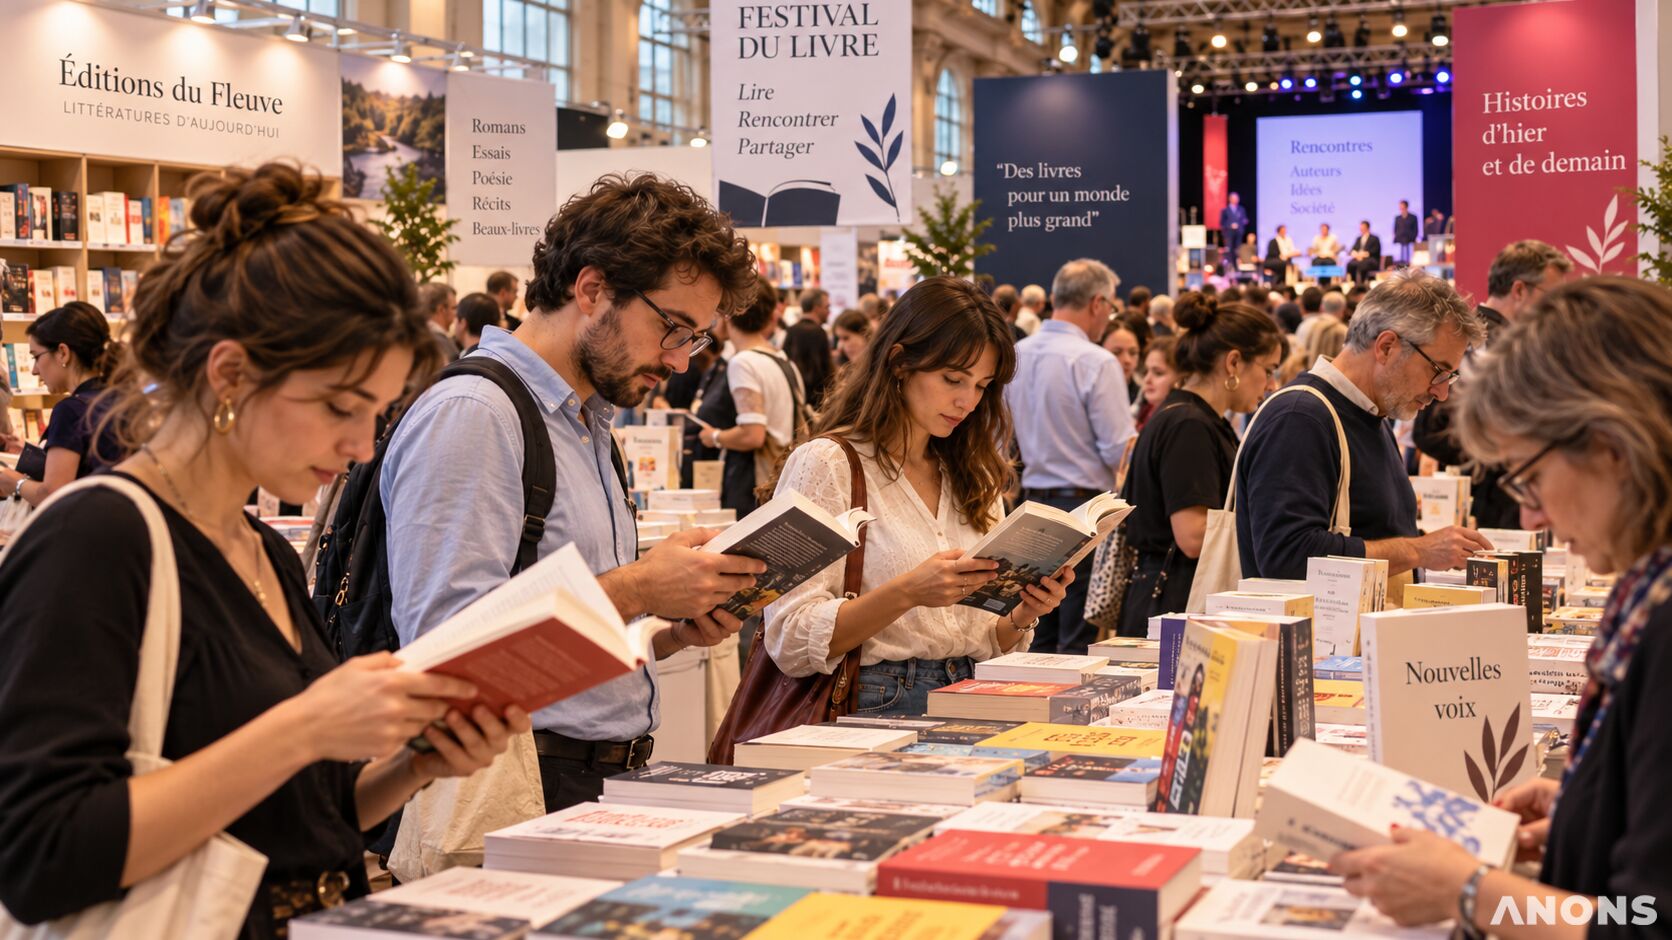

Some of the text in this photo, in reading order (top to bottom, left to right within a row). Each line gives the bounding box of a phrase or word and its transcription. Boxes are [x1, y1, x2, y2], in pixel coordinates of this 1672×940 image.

[738, 3, 880, 29] FESTIVAL
[738, 33, 880, 60] DU LIVRE
[58, 53, 283, 115] Éditions du Fleuve
[738, 83, 775, 101] Lire
[1482, 87, 1589, 114] Histoires
[63, 101, 281, 139] LITTÉRATURES D'AUJOURD'HUI
[472, 118, 527, 136] Romans
[738, 110, 839, 128] Rencontrer
[472, 144, 512, 160] Essais
[738, 137, 815, 159] Partager
[1290, 139, 1374, 154] Rencontres
[1038, 162, 1083, 179] livres
[1289, 165, 1343, 178] Auteurs
[1482, 149, 1628, 176] et de demain
[472, 170, 514, 186] Poésie
[1007, 184, 1131, 207] pour un monde
[1290, 182, 1323, 197] Idées
[472, 195, 512, 212] Récits
[1290, 201, 1336, 215] Société
[472, 221, 541, 236] Beaux-livres
[1007, 211, 1041, 232] plus
[1404, 656, 1502, 685] Nouvelles
[1433, 695, 1477, 720] voix
